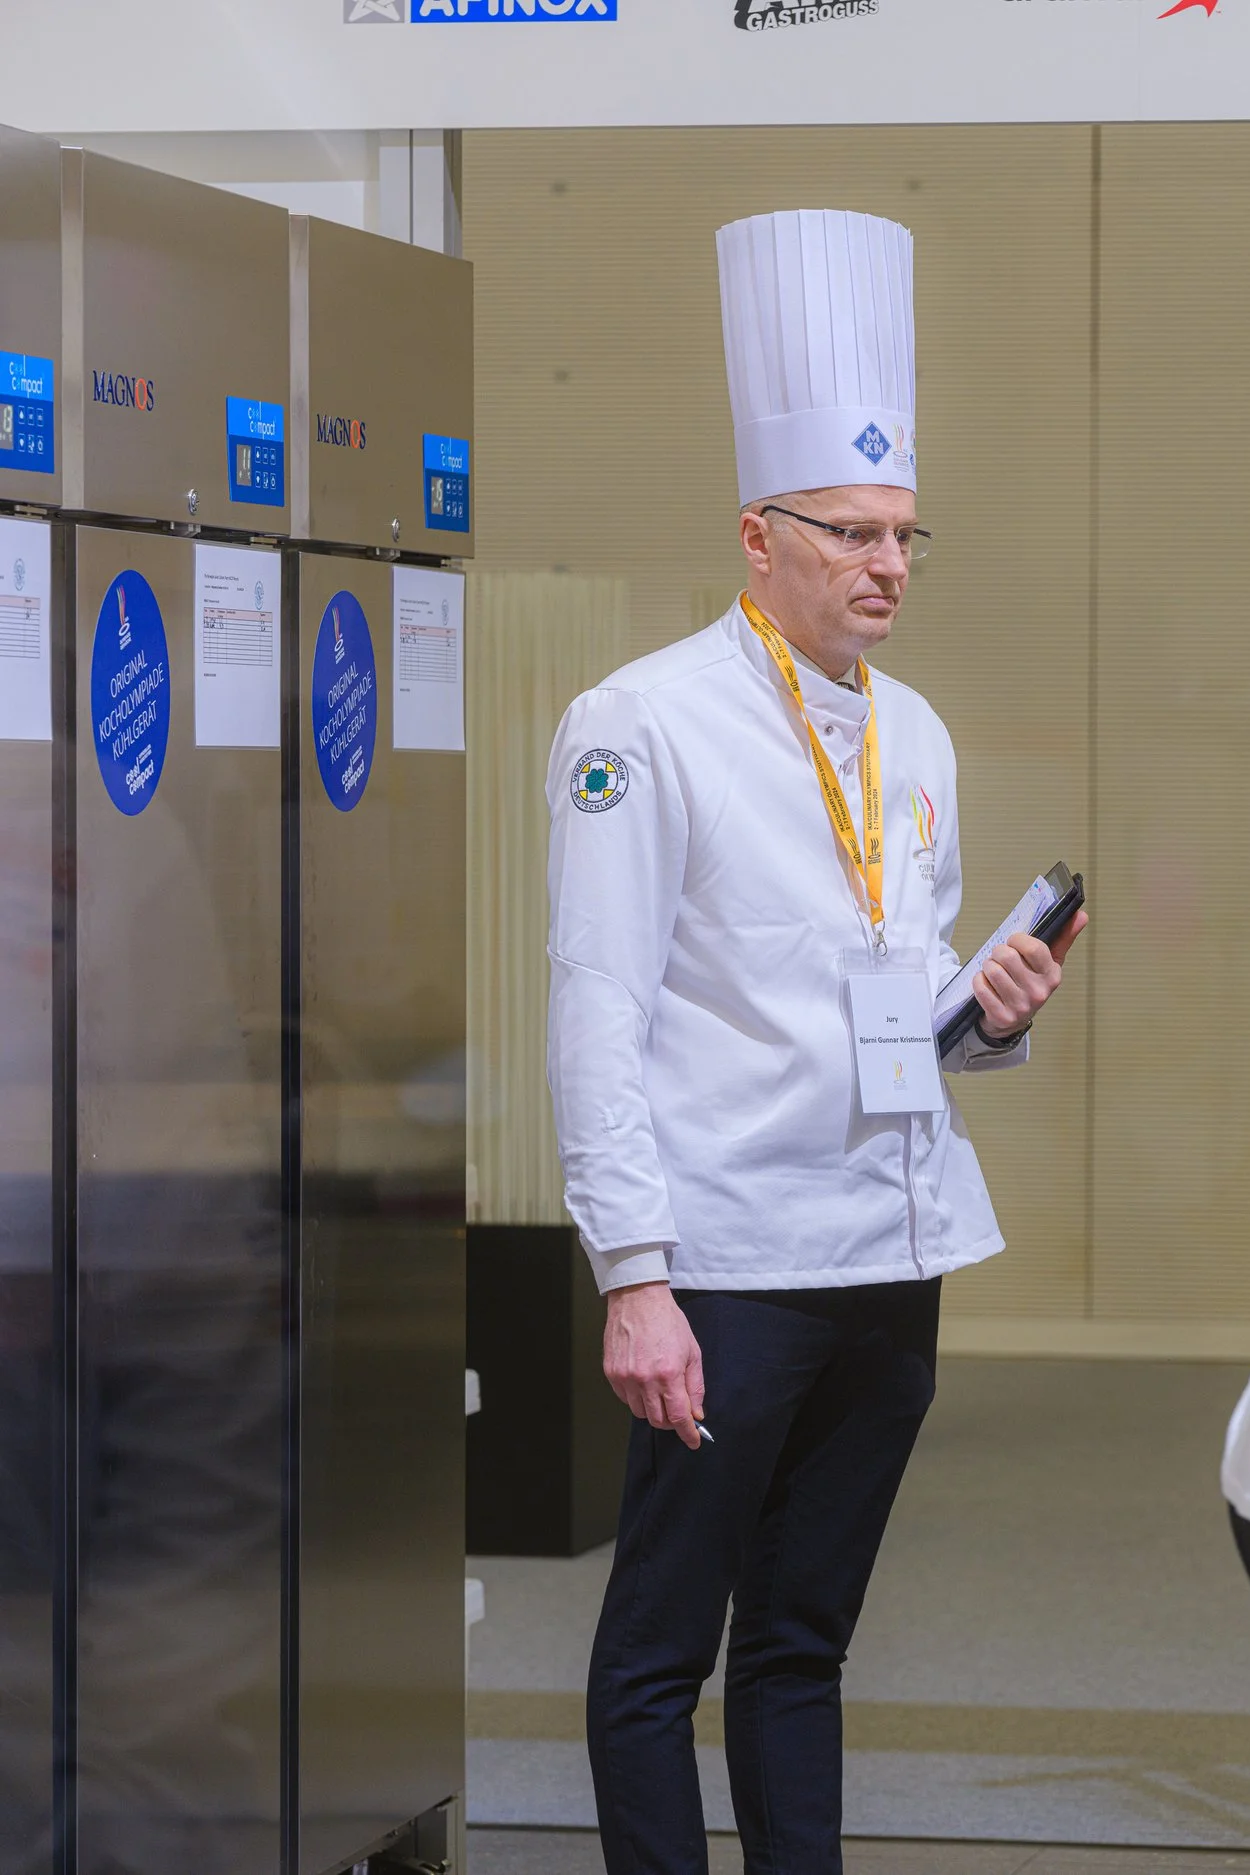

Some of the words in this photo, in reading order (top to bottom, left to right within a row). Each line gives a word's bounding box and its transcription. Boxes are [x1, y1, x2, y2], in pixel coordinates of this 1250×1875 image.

[746, 0, 879, 31] GASTROGUSS
[93, 370, 155, 411] MAGNOS
[317, 414, 366, 449] MAGNOS
[110, 650, 148, 698] ORIGINAL
[328, 661, 358, 708] ORIGINAL
[99, 662, 165, 743] KOCHOLYMPIADE
[319, 670, 373, 750] KOCHOLYMPIADE
[112, 700, 157, 761] KÜHLGERÄT
[330, 704, 367, 765] KÜHLGERÄT
[597, 752, 611, 760] DER
[573, 790, 622, 810] DEUTSCHLANDS
[886, 1016, 899, 1024] Jury
